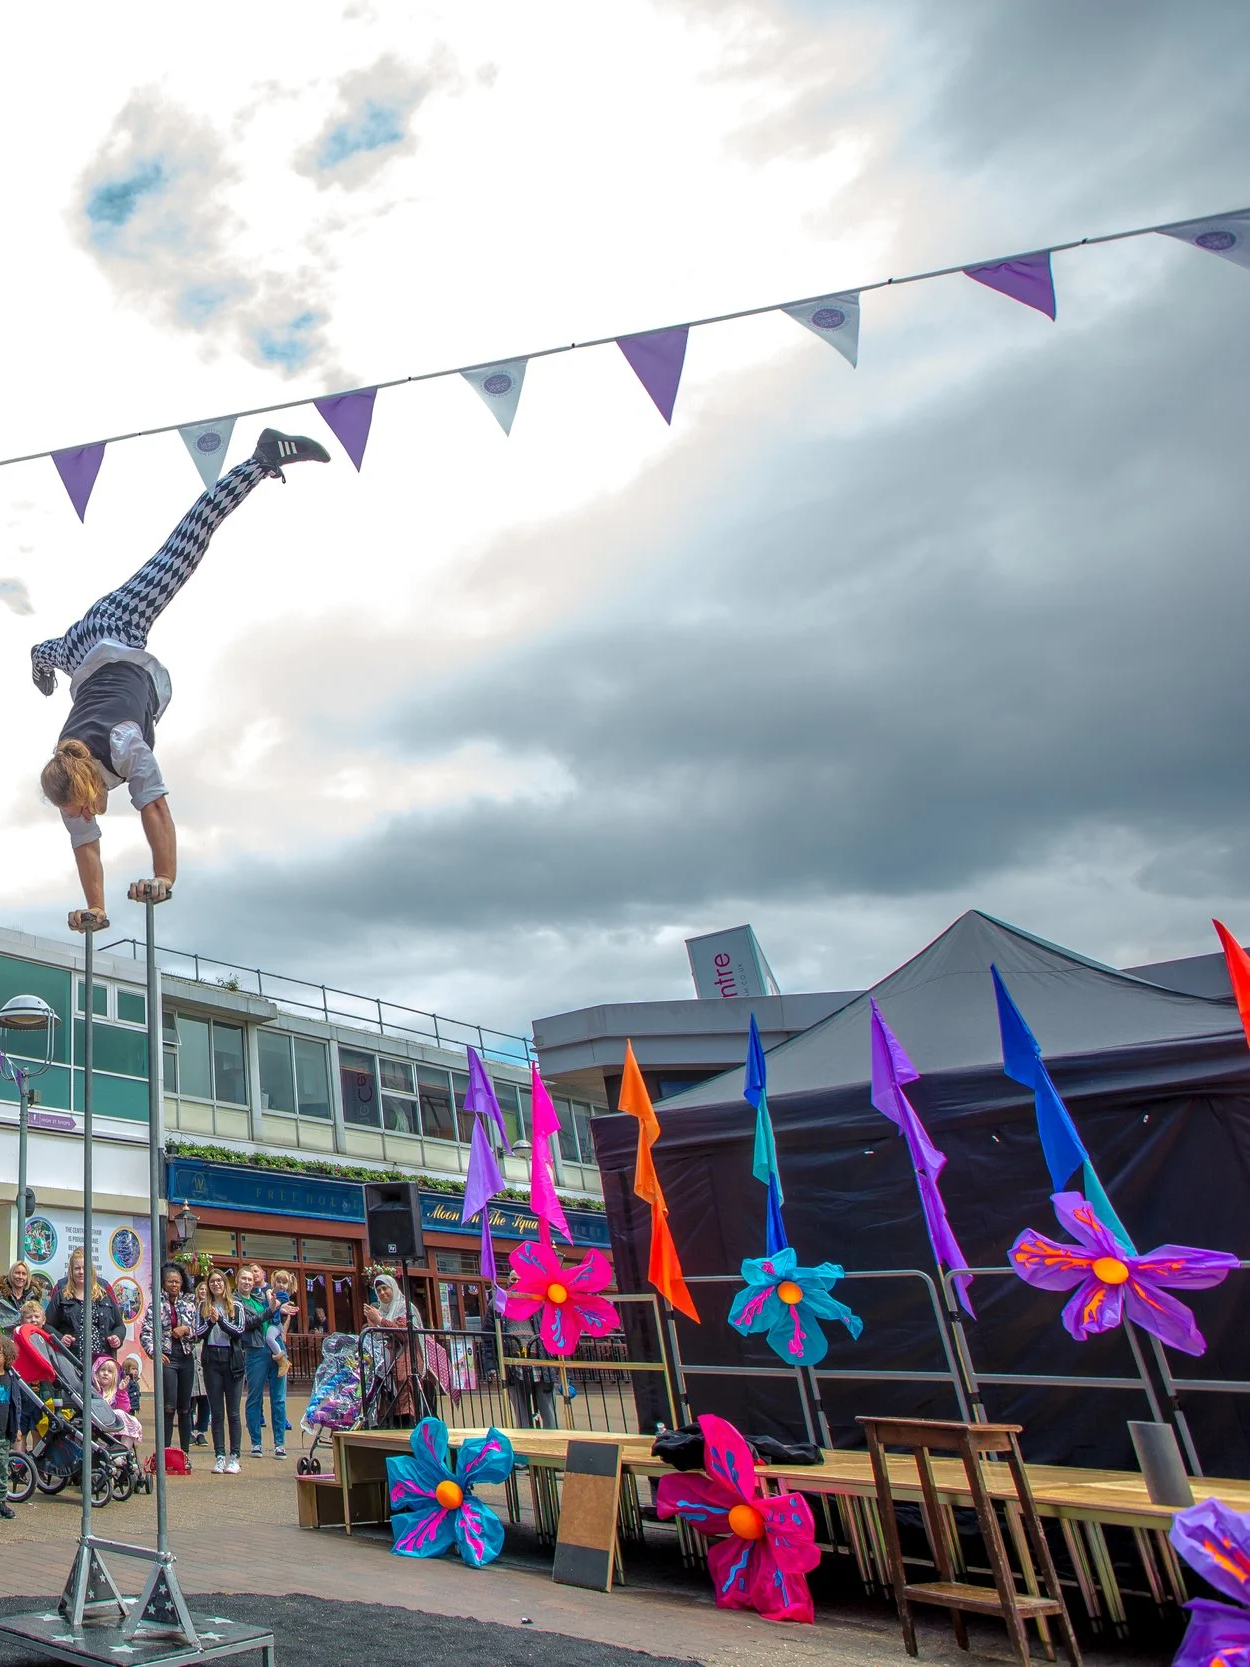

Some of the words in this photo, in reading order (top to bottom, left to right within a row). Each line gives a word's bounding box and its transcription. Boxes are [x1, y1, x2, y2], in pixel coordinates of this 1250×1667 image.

[714, 953, 738, 998] ntre
[426, 1204, 460, 1221] Moon
[488, 1210, 506, 1226] The
[511, 1215, 539, 1234] Squa
